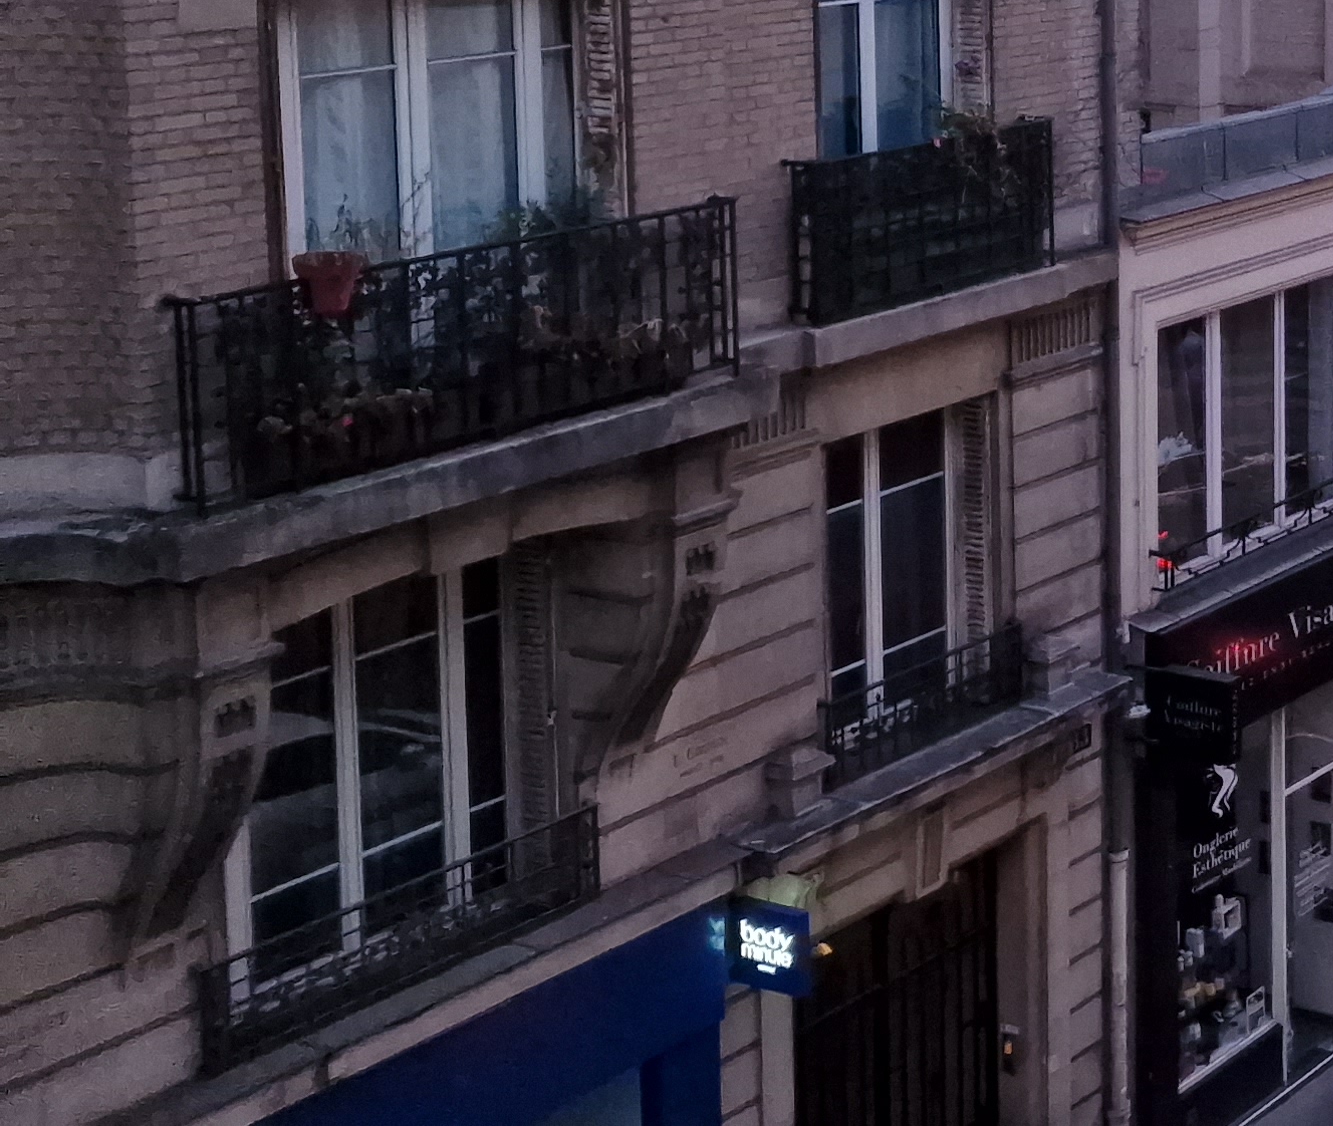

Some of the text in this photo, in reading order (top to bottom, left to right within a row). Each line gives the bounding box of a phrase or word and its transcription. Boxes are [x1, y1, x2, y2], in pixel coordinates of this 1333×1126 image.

[1192, 826, 1239, 859] Onglerie
[1192, 838, 1251, 879] Esthétique
[739, 918, 795, 952] body
[740, 942, 794, 969] minute
